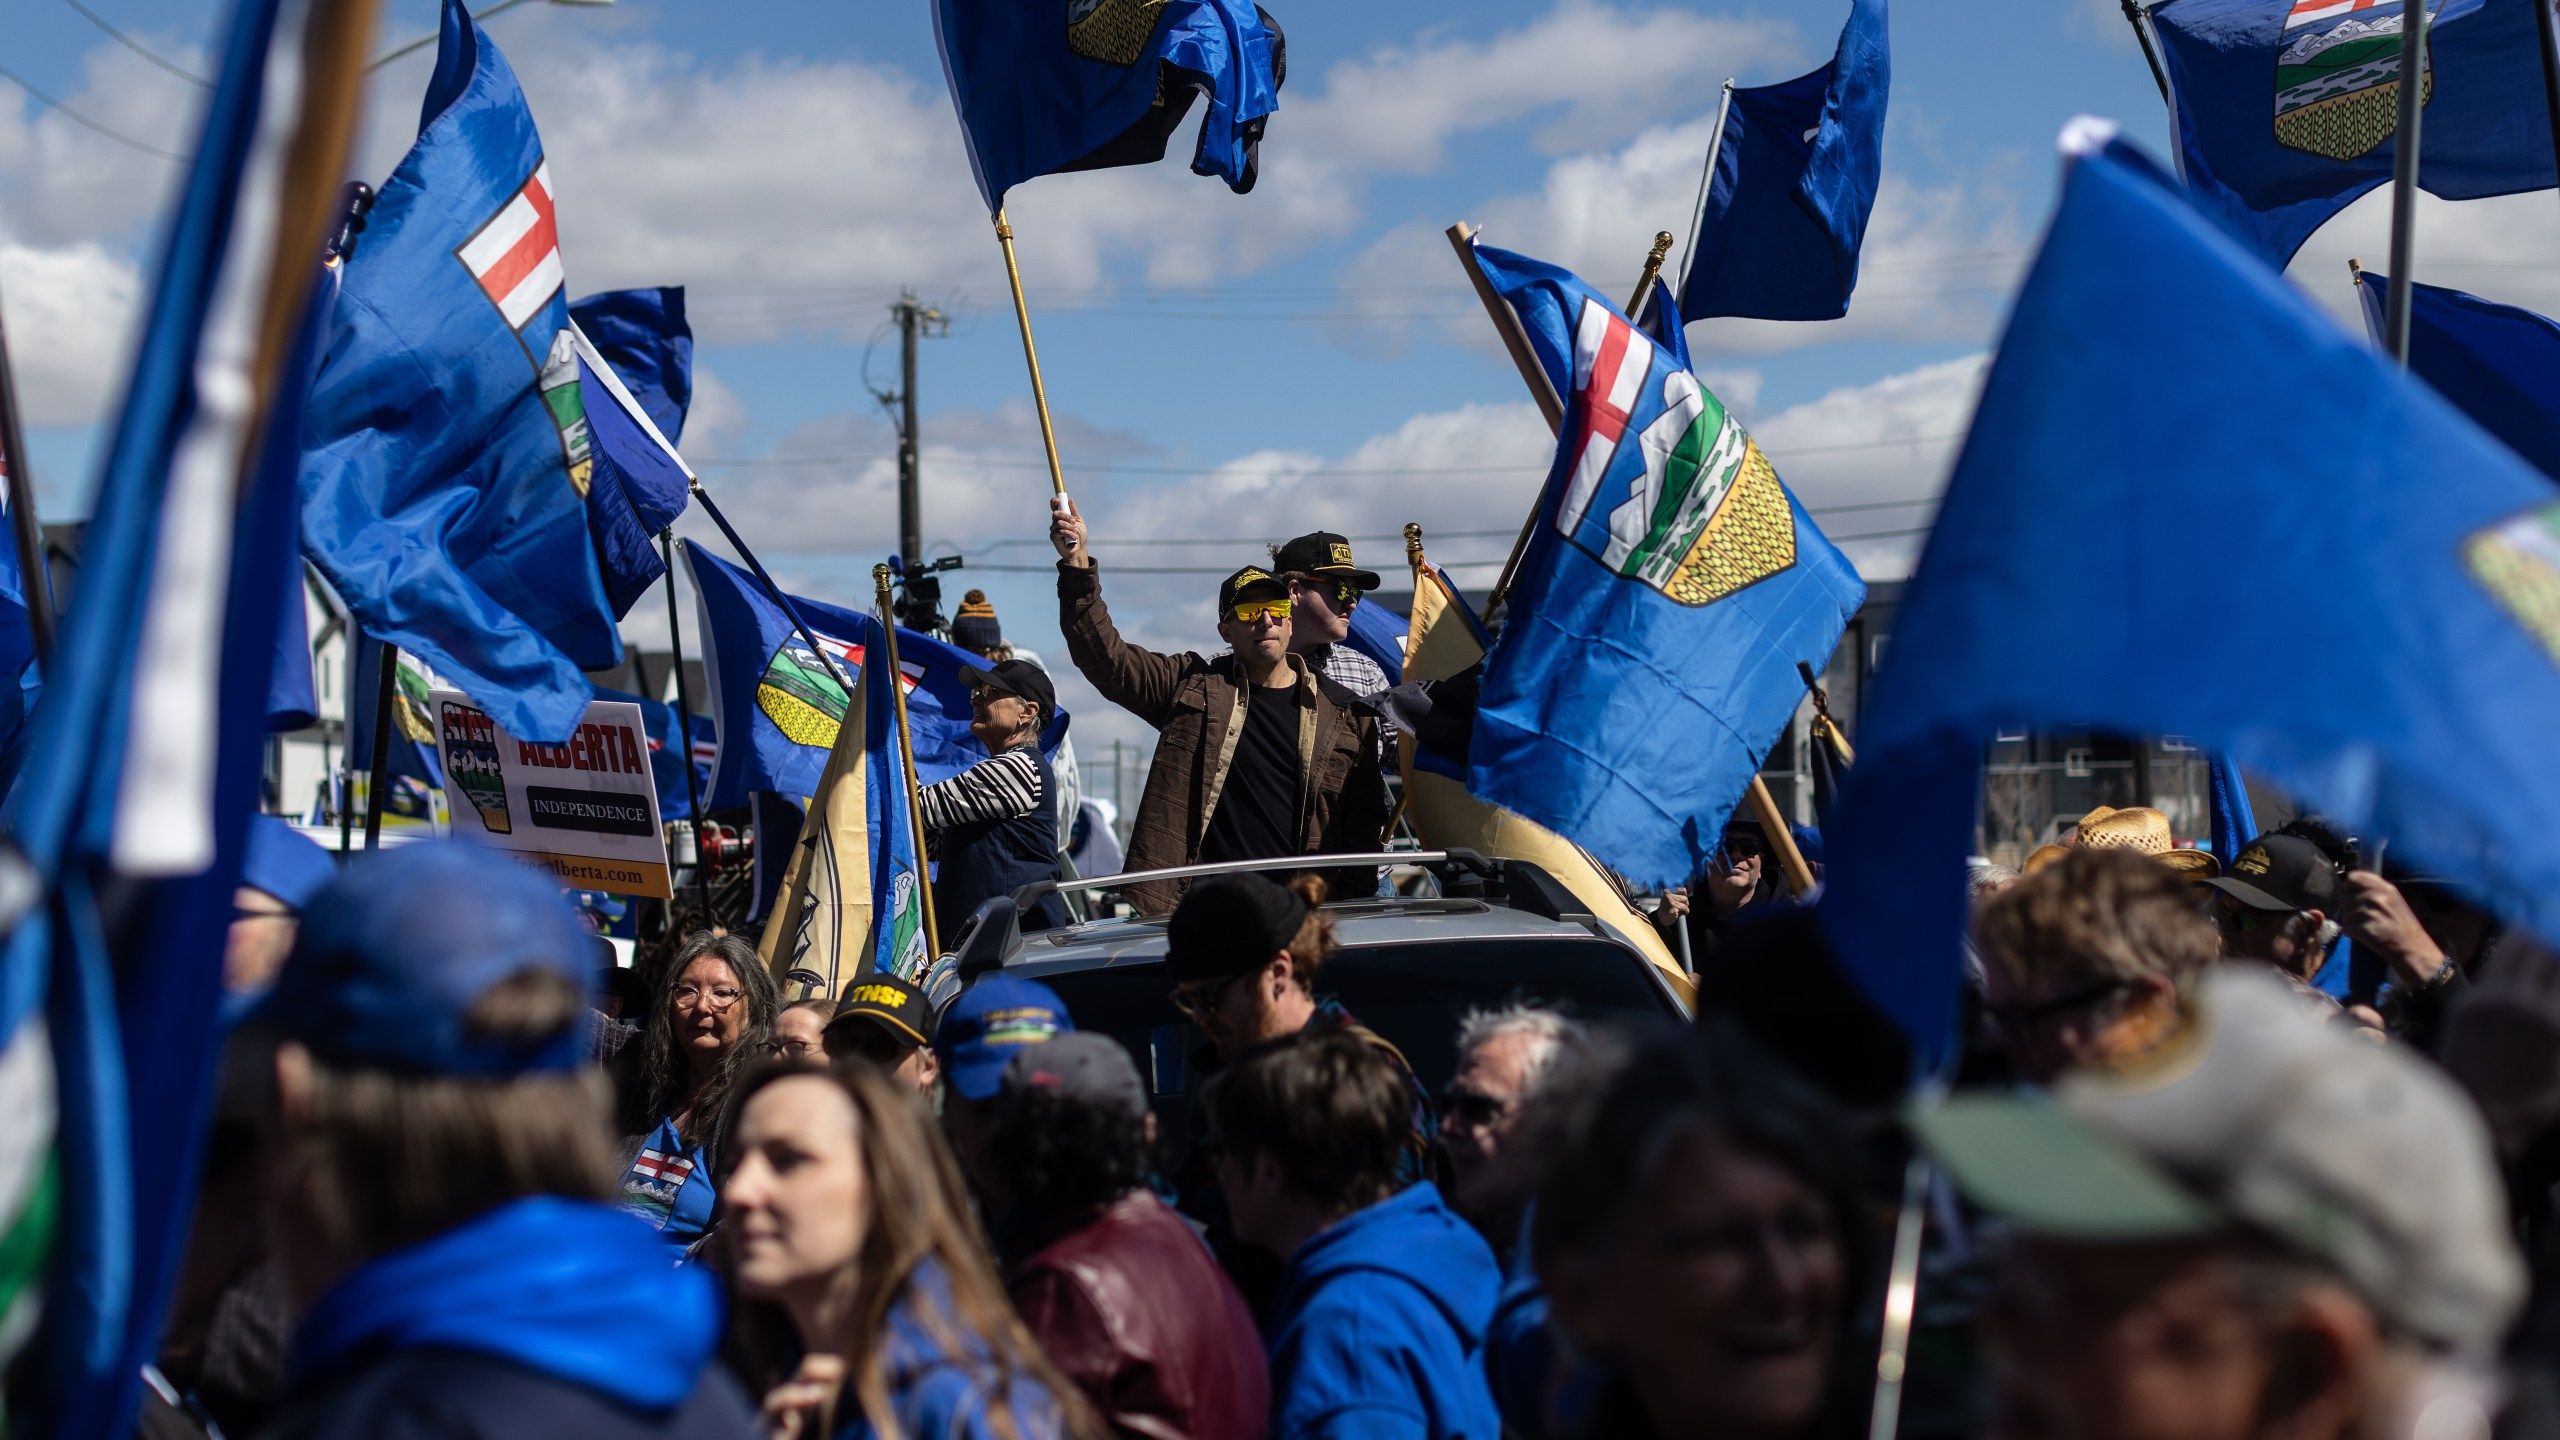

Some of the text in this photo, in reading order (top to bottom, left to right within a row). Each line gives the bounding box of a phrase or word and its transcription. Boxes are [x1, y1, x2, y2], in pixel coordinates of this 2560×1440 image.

[443, 703, 494, 742] STAY
[533, 799, 646, 822] INDEPENDENCE
[513, 855, 644, 884] freelberta.com
[852, 984, 908, 1009] TNSF
